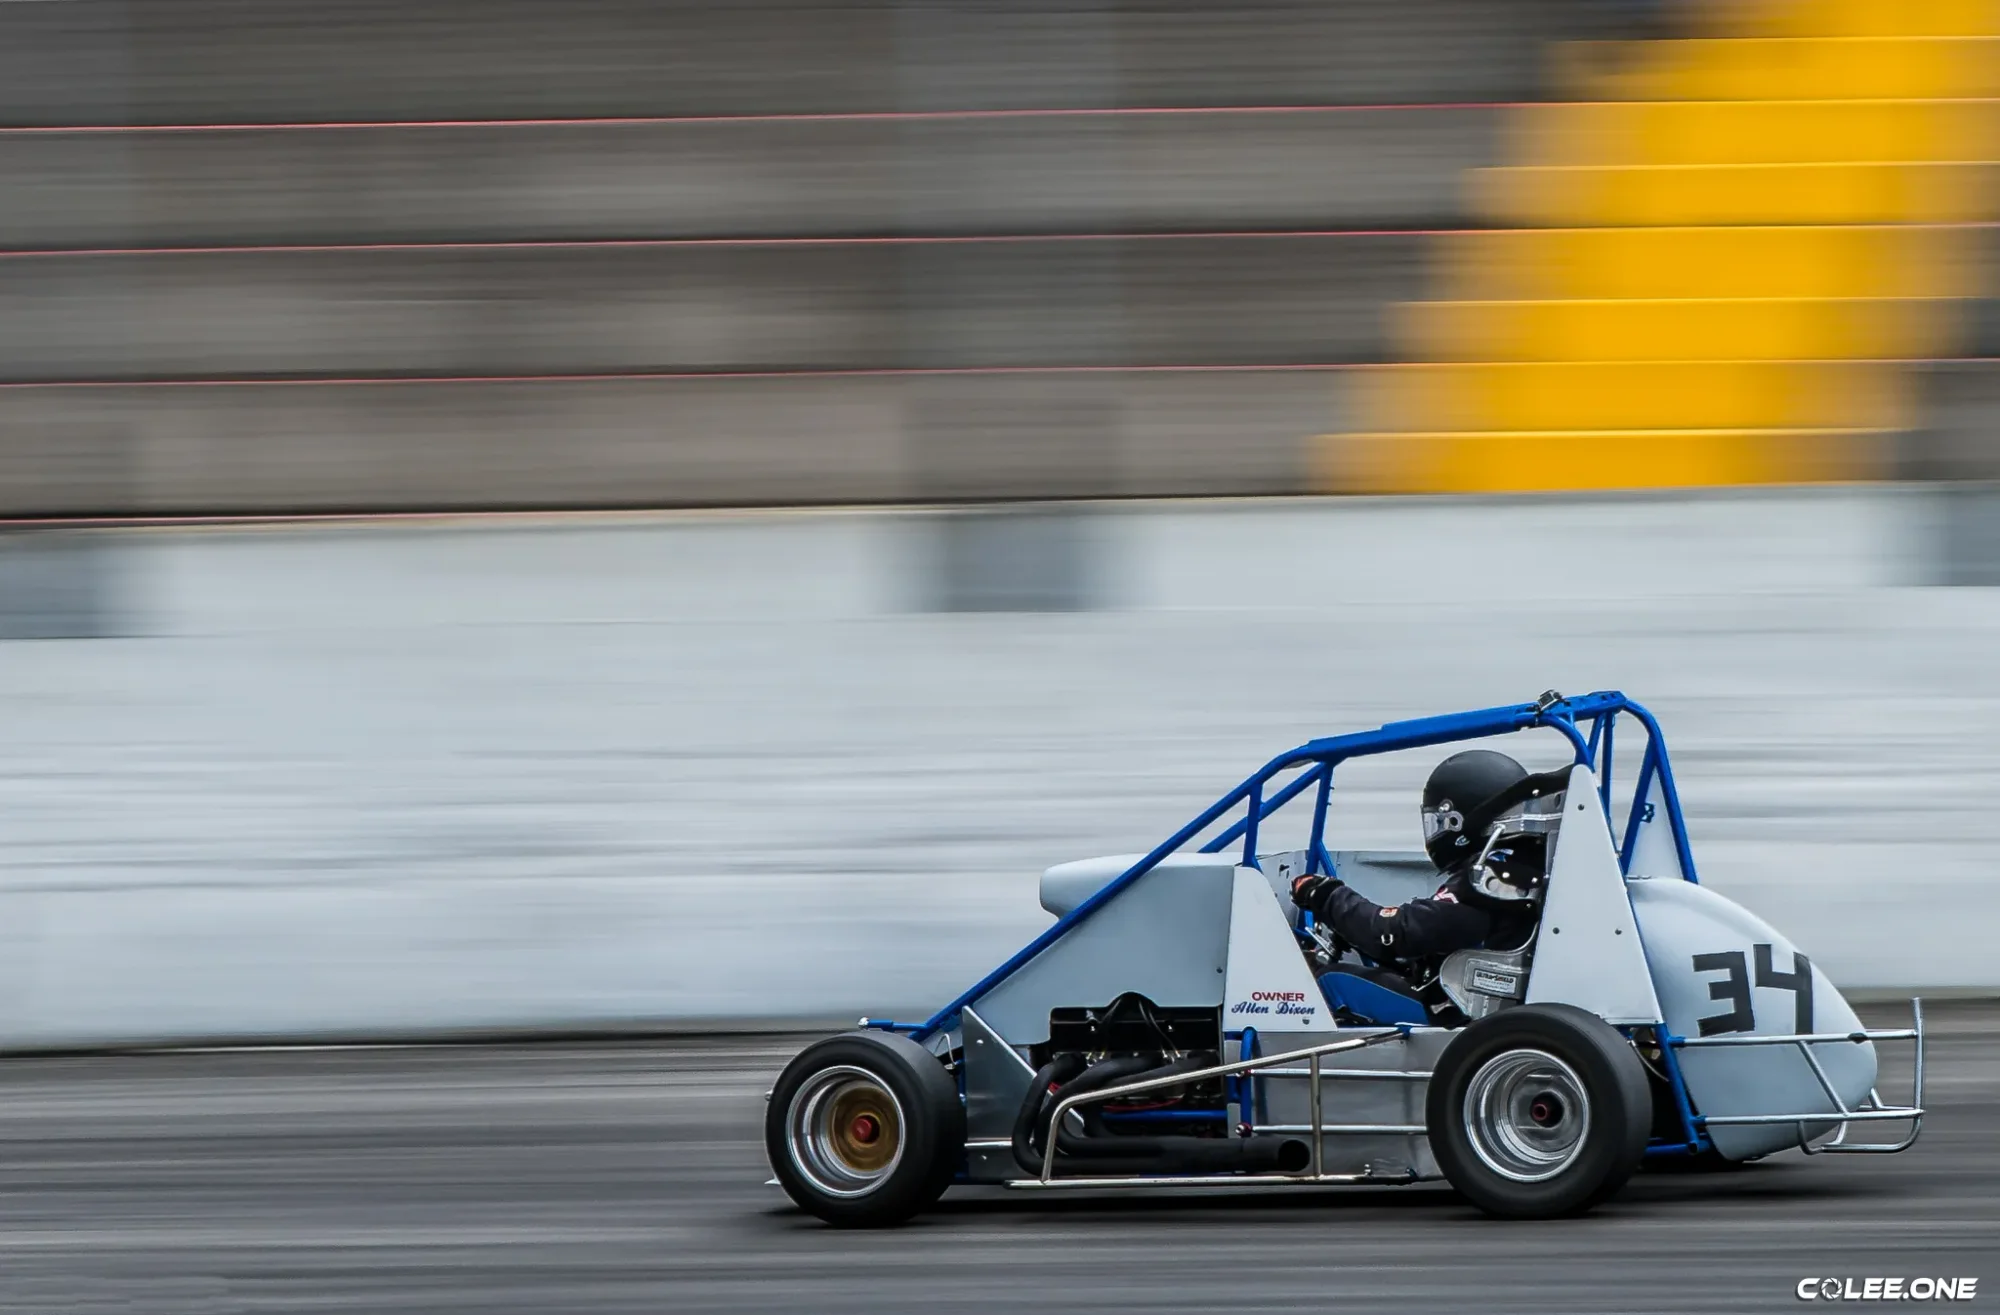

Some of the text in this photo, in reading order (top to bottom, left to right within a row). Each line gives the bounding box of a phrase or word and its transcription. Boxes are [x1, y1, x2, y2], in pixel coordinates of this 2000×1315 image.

[1251, 991, 1305, 1002] OWNER
[1692, 943, 1814, 1037] 34
[1231, 1001, 1315, 1015] Allen Dixon
